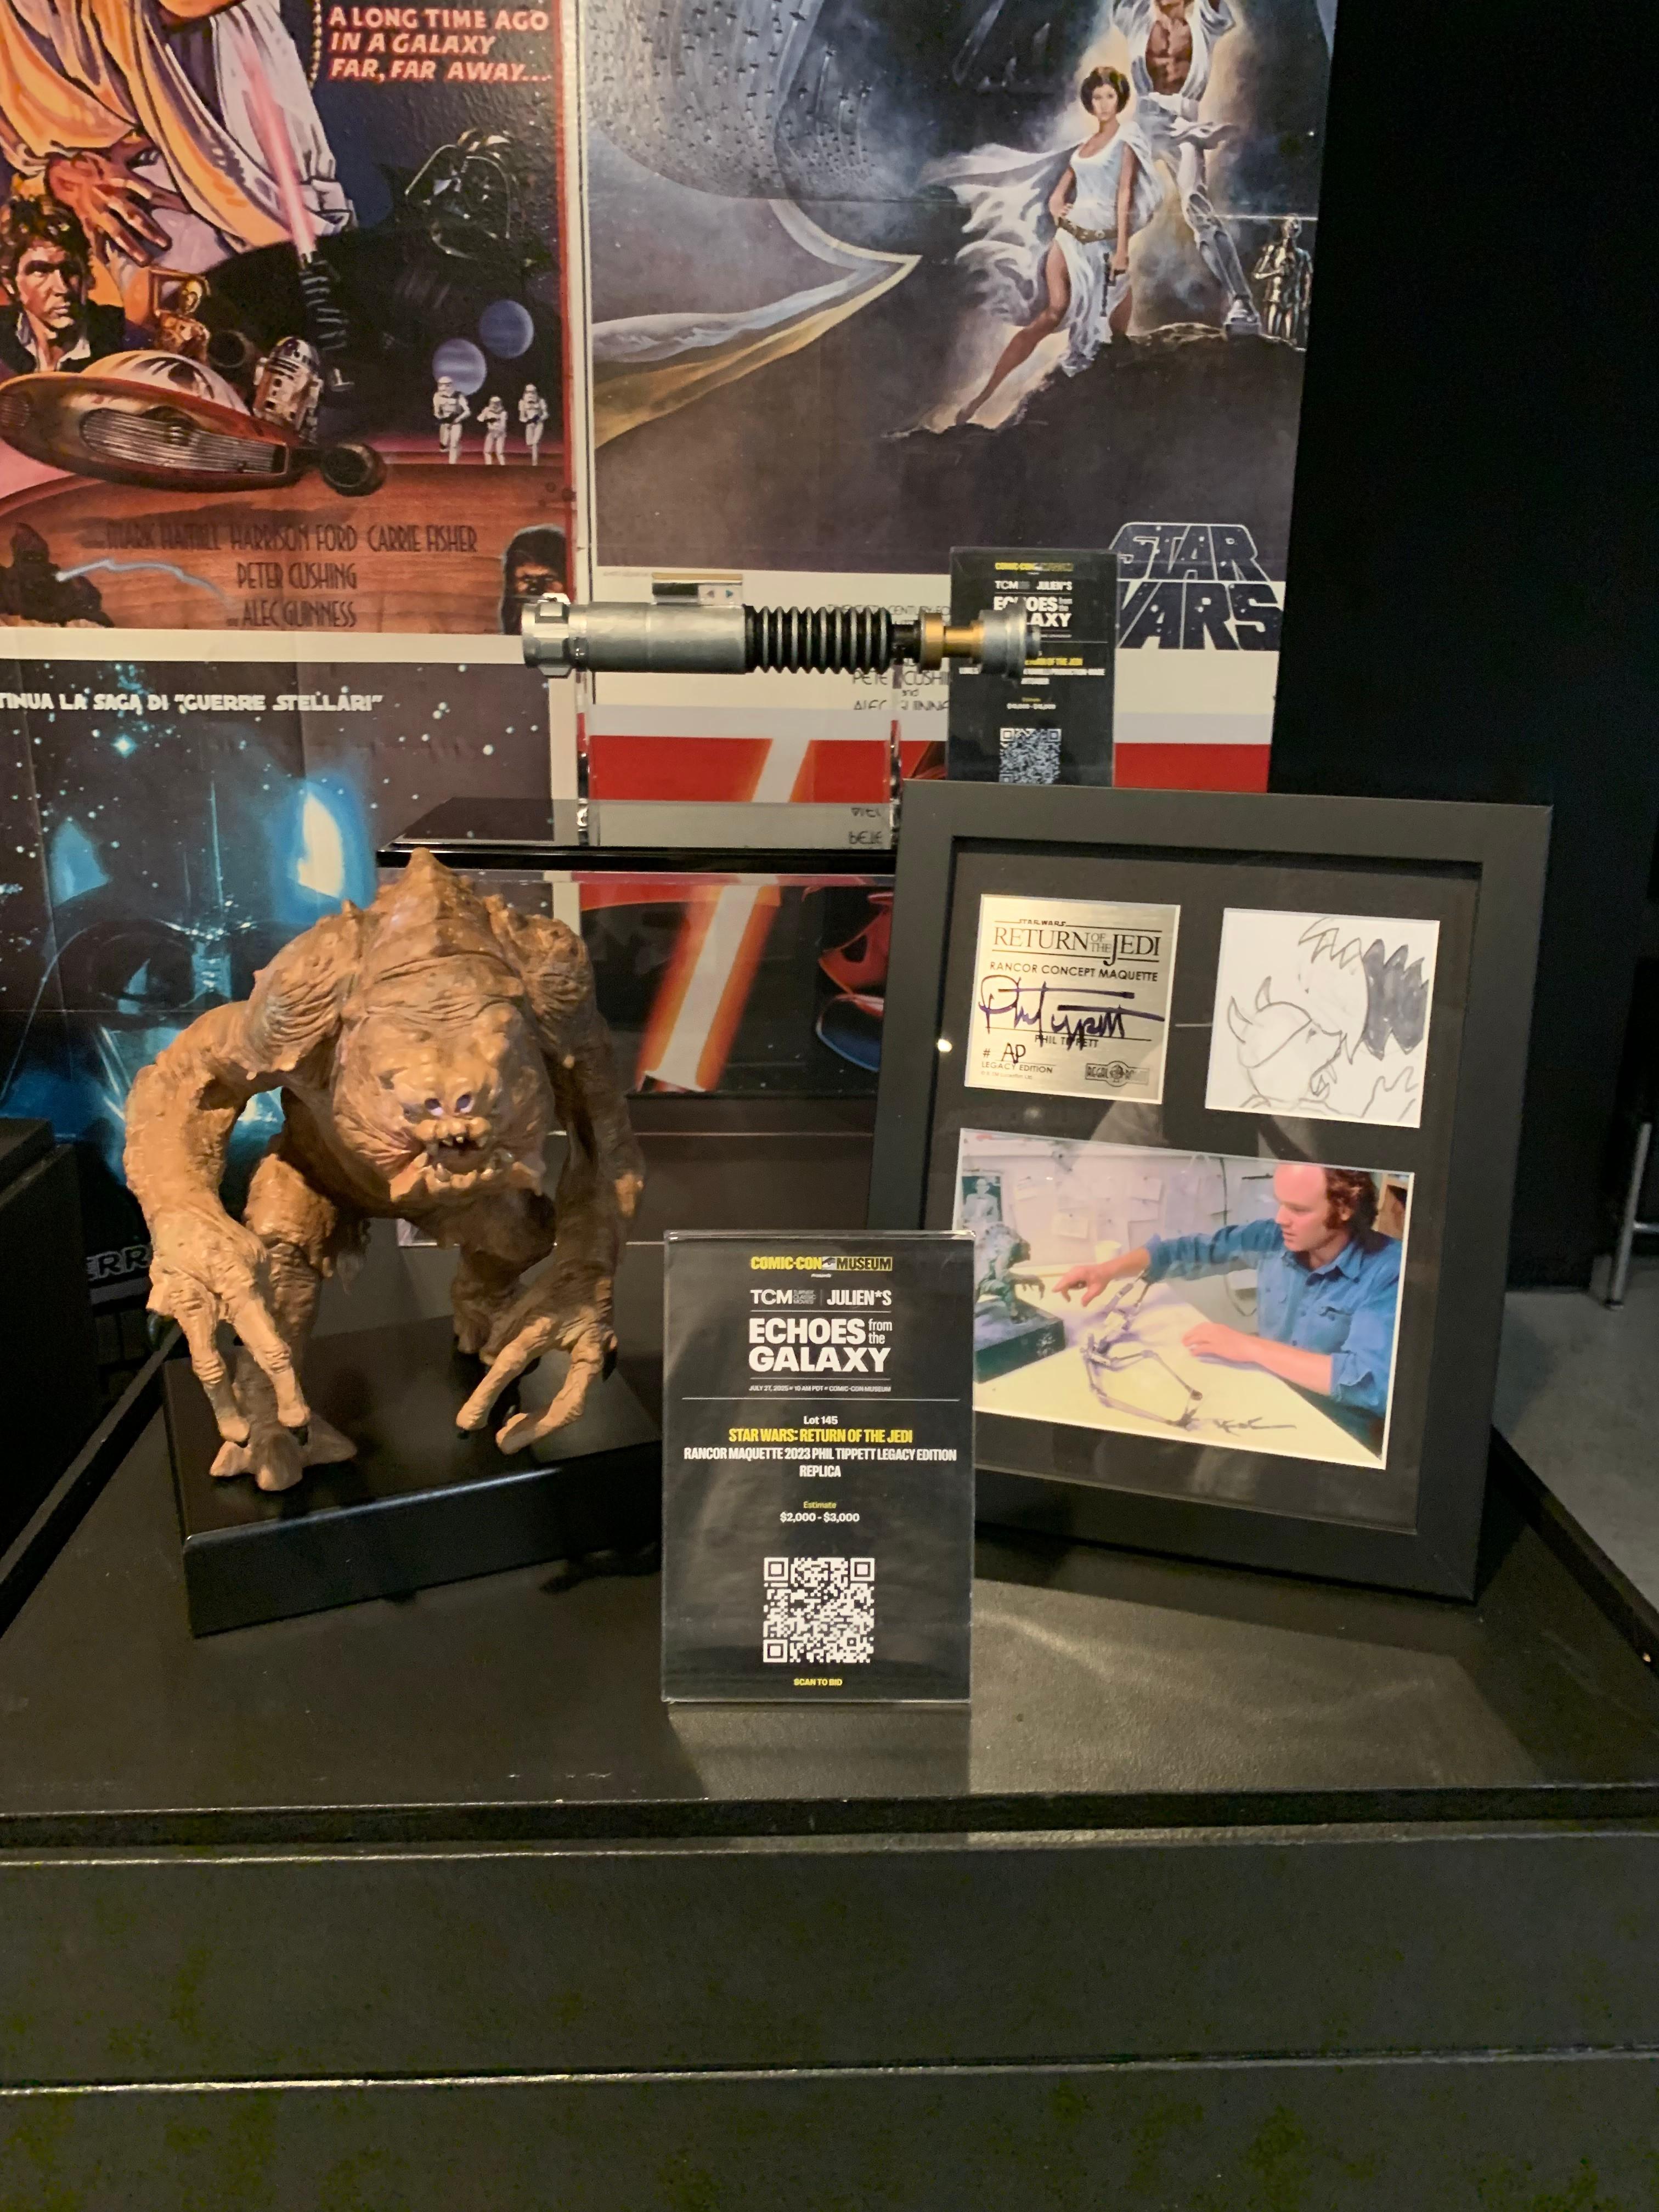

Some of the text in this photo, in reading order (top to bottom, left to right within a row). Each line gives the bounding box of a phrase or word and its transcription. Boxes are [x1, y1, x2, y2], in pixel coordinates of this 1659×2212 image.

[330, 7, 549, 31] A LONG TIME AGO
[331, 32, 495, 54] IN A GALAXY
[331, 59, 384, 83] FAR,
[391, 60, 436, 78] FAR
[230, 525, 308, 551] HARRISON
[317, 525, 358, 551] FORD
[367, 525, 421, 552] CARRIE
[427, 525, 477, 552] FISHER
[1109, 522, 1269, 580] STAR
[237, 562, 357, 590] PETER CUSHING
[242, 599, 357, 628] ALEC GUINNESS
[59, 693, 88, 710] LA
[93, 693, 143, 715] SAGA
[147, 694, 169, 710] DI
[994, 927, 1161, 967] RETURN OF THE JEDI
[990, 961, 1158, 982] RANCOR CONCEPT MAQUETTE
[1001, 1042, 1026, 1064] AP
[981, 1061, 1053, 1074] LEGACY EDITION
[751, 1256, 891, 1270] COMIC-CON MUSEUM
[750, 1289, 793, 1305] TCM
[749, 1318, 893, 1345] ECHOES from
[868, 1333, 885, 1344] the
[748, 1346, 891, 1373] GALAXY
[803, 1415, 838, 1425] Lot 145
[729, 1428, 913, 1443] STAR WARS: RETURN OF THE JEDI
[684, 1447, 957, 1462] RANCOR MAQUETTE 2023 PHIL TIPPETT LEGACY EDITION
[799, 1465, 842, 1478] REPLICA
[803, 1500, 837, 1509] Estimate
[779, 1511, 816, 1523] $2,000
[823, 1511, 860, 1523] $3,000
[793, 1678, 843, 1686] SCAN TO BID
